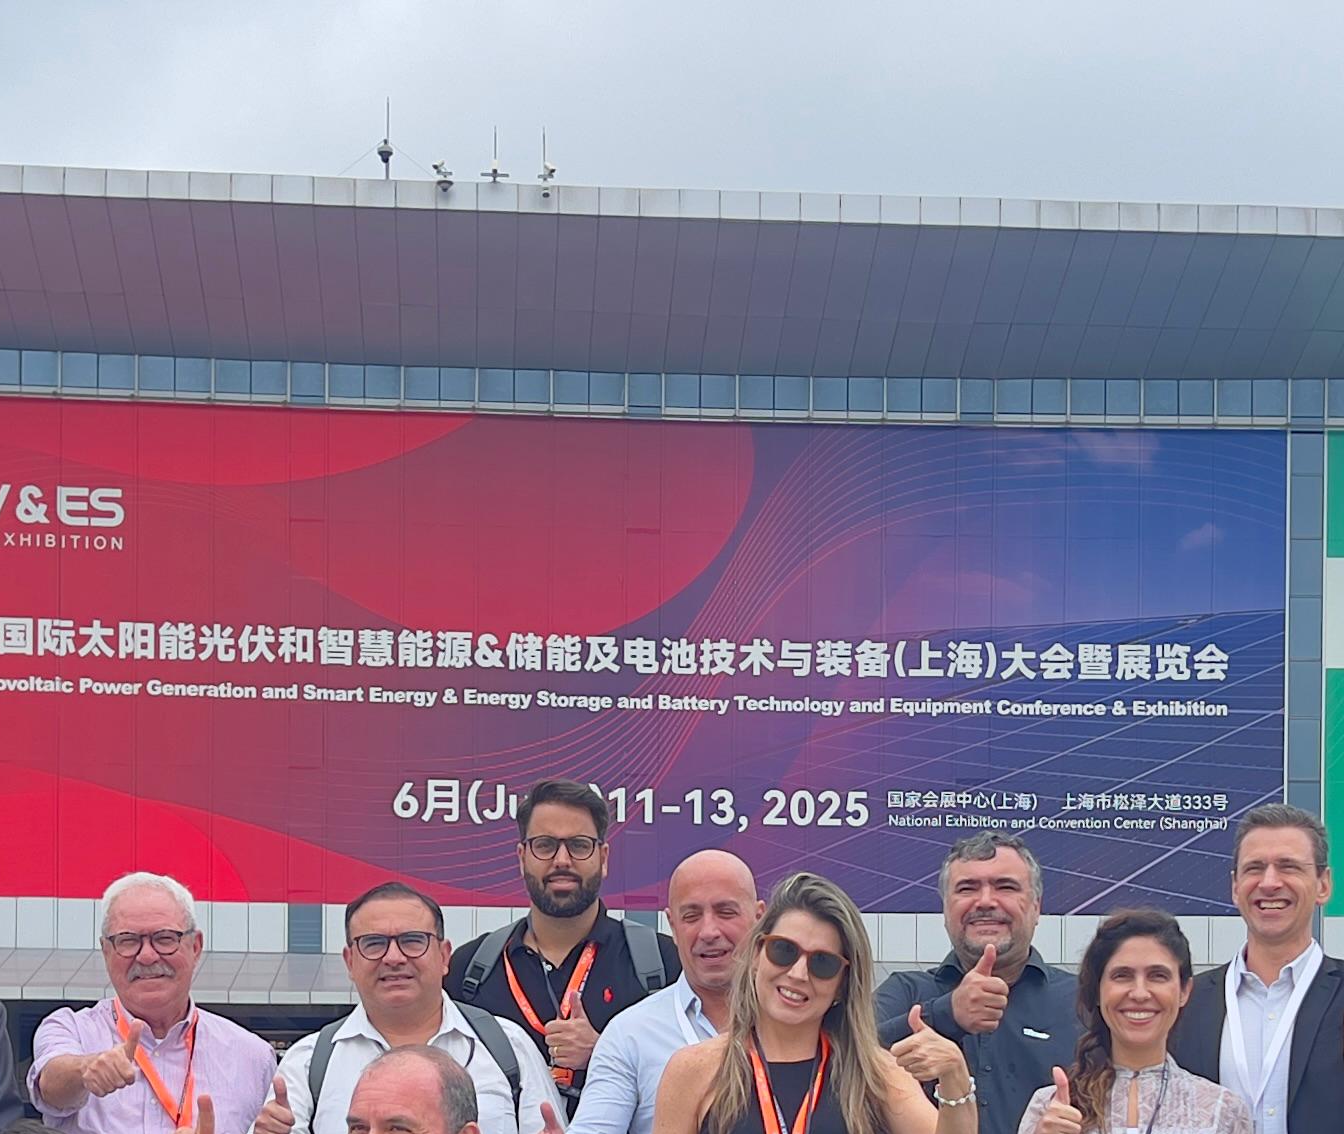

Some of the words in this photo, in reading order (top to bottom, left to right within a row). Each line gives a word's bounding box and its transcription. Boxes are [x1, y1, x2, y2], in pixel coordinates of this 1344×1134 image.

[79, 677, 143, 696] Power
[146, 680, 258, 699] Generation
[262, 684, 298, 700] and
[303, 684, 365, 703] Smart
[369, 687, 438, 707] Energy
[442, 688, 459, 706] &
[463, 689, 532, 710] Energy
[536, 690, 613, 711] Storage
[618, 693, 654, 711] and
[658, 694, 730, 716] Battery
[734, 695, 845, 718] Technology
[849, 698, 885, 716] and
[889, 698, 992, 719] Equipment
[996, 699, 1108, 718] Conference
[1111, 700, 1128, 717] &
[1132, 700, 1228, 718] Exhibition
[761, 789, 870, 827] 2025
[886, 790, 1038, 812] 国家会展中心(上海)
[888, 813, 942, 829] National
[944, 814, 1008, 829] Exhibition
[1010, 816, 1036, 830] and
[1038, 816, 1111, 831] Convention
[1113, 816, 1156, 831] Center
[1159, 817, 1229, 834] (Shanghai)
